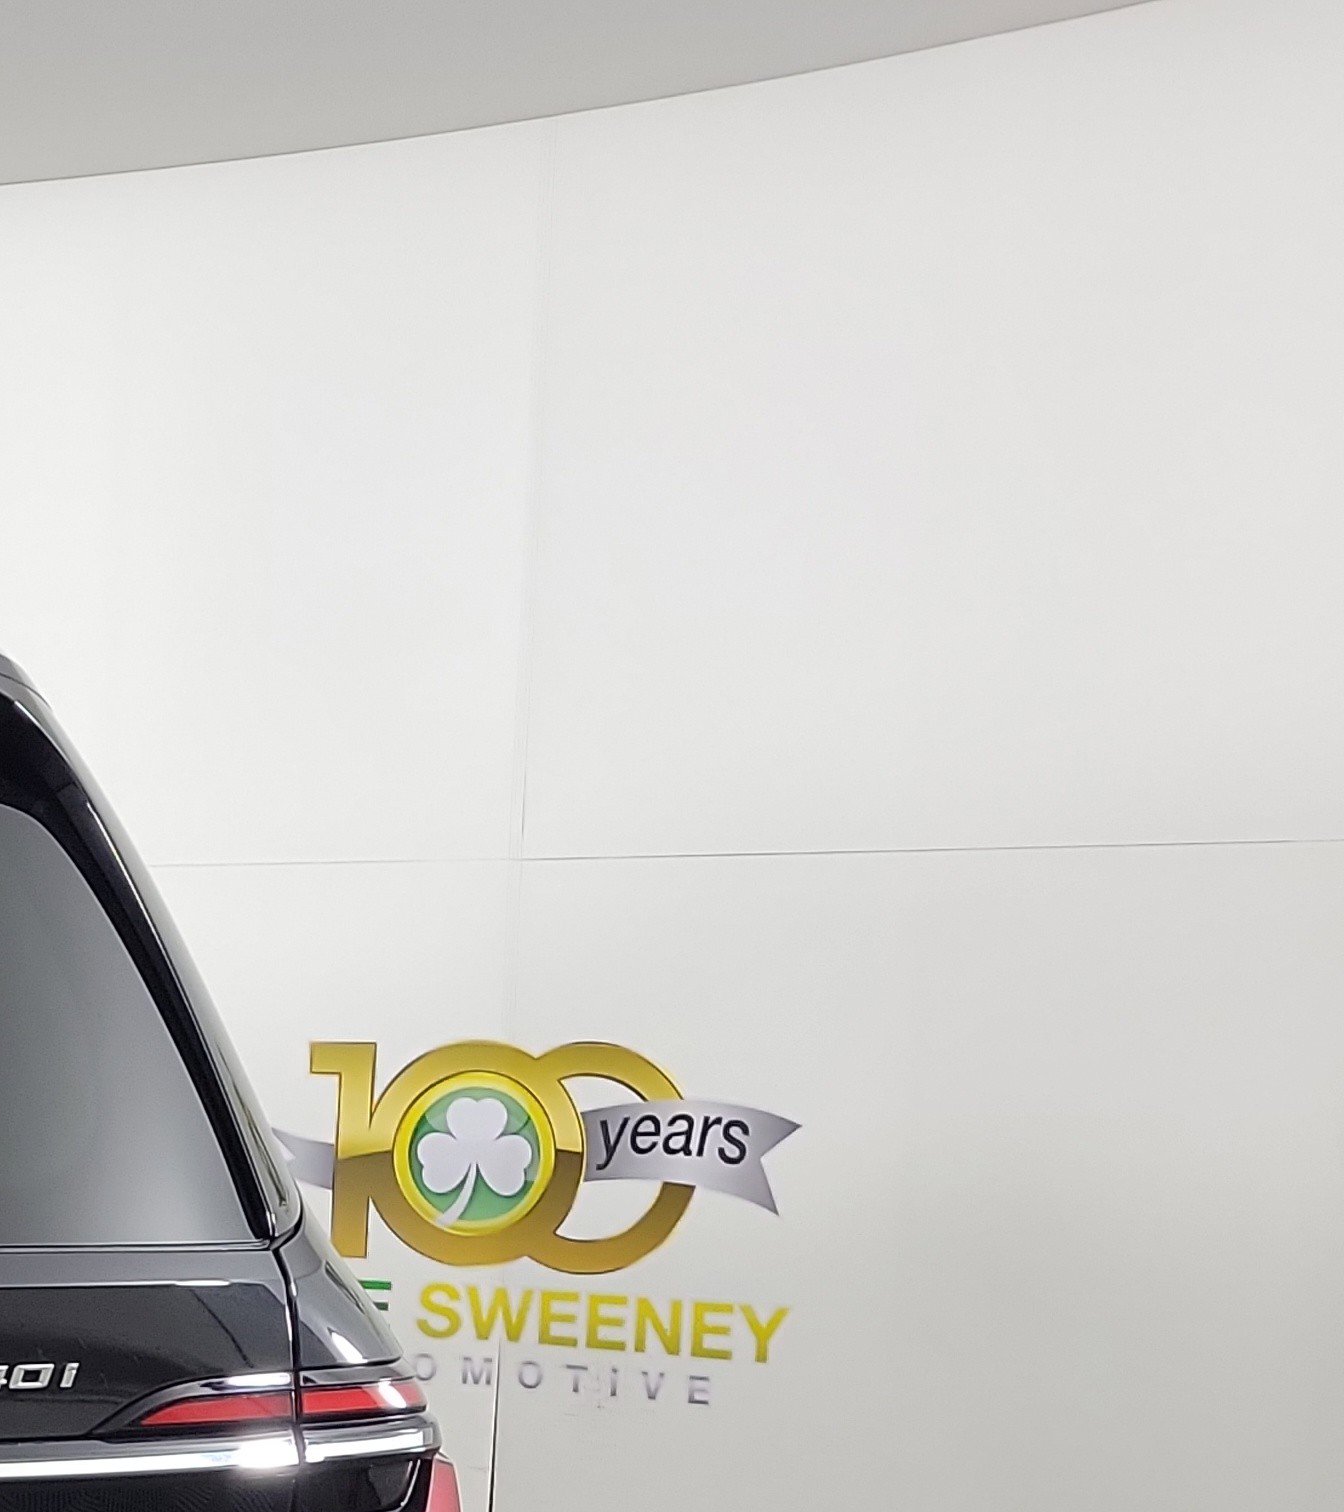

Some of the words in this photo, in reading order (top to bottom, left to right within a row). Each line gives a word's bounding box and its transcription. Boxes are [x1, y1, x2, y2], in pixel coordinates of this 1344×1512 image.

[309, 1040, 696, 1275] 100
[595, 1110, 750, 1171] years
[415, 1281, 791, 1365] SWEENEY
[413, 1353, 712, 1406] OMOTIVE
